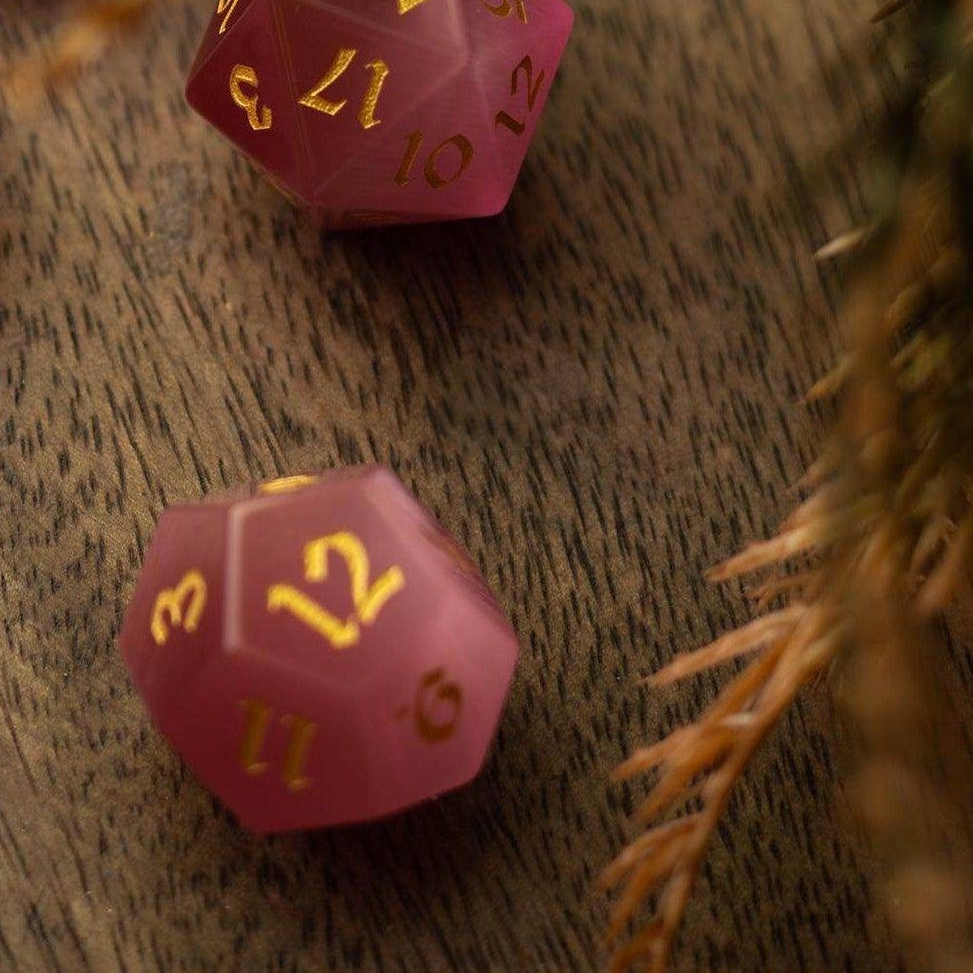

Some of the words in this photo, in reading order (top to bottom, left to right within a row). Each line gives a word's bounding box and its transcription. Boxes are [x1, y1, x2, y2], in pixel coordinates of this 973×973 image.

[229, 63, 273, 131] 3
[298, 47, 391, 130] 17
[494, 54, 546, 139] 12
[392, 130, 475, 189] 10
[151, 568, 208, 646] 3
[267, 532, 405, 649] 12
[237, 698, 318, 792] 11
